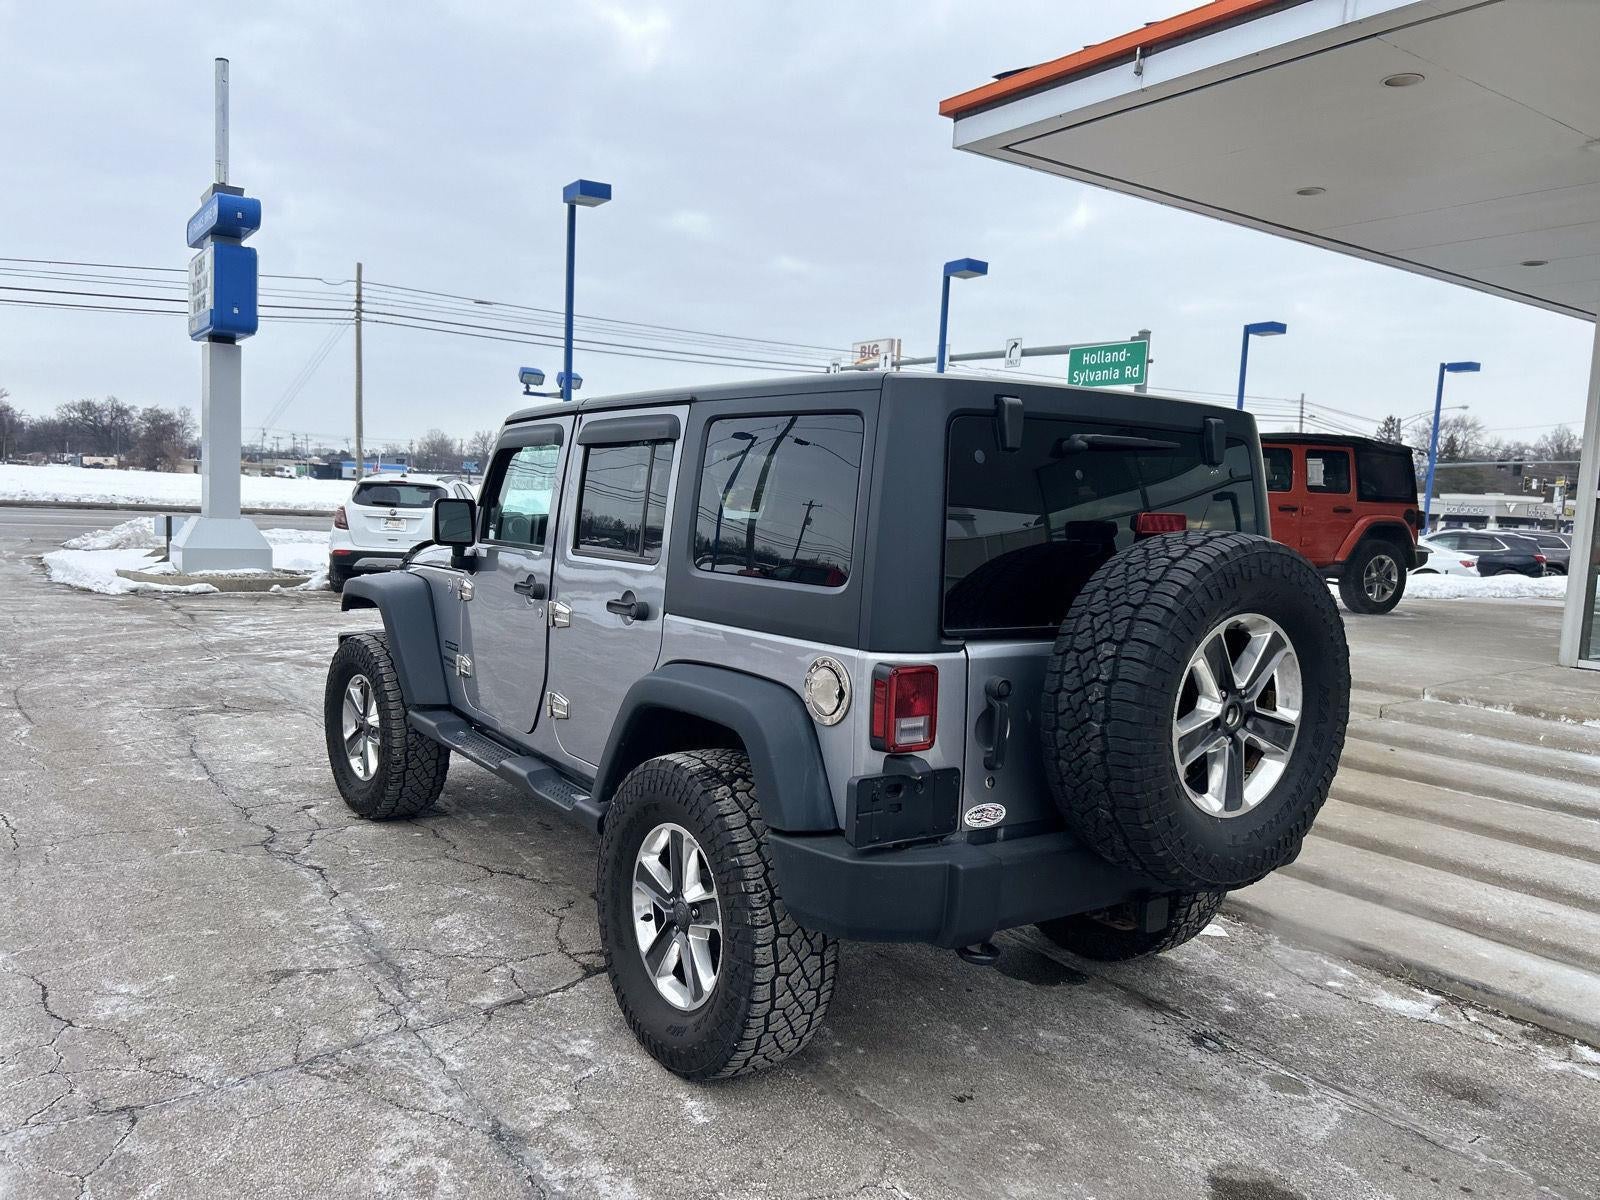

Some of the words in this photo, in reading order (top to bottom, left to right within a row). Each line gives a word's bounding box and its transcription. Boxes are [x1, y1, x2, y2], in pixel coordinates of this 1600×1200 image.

[860, 343, 880, 358] BIG
[1082, 348, 1131, 365] Holland-
[1072, 367, 1120, 386] Sylvania
[1125, 364, 1140, 378] Rd
